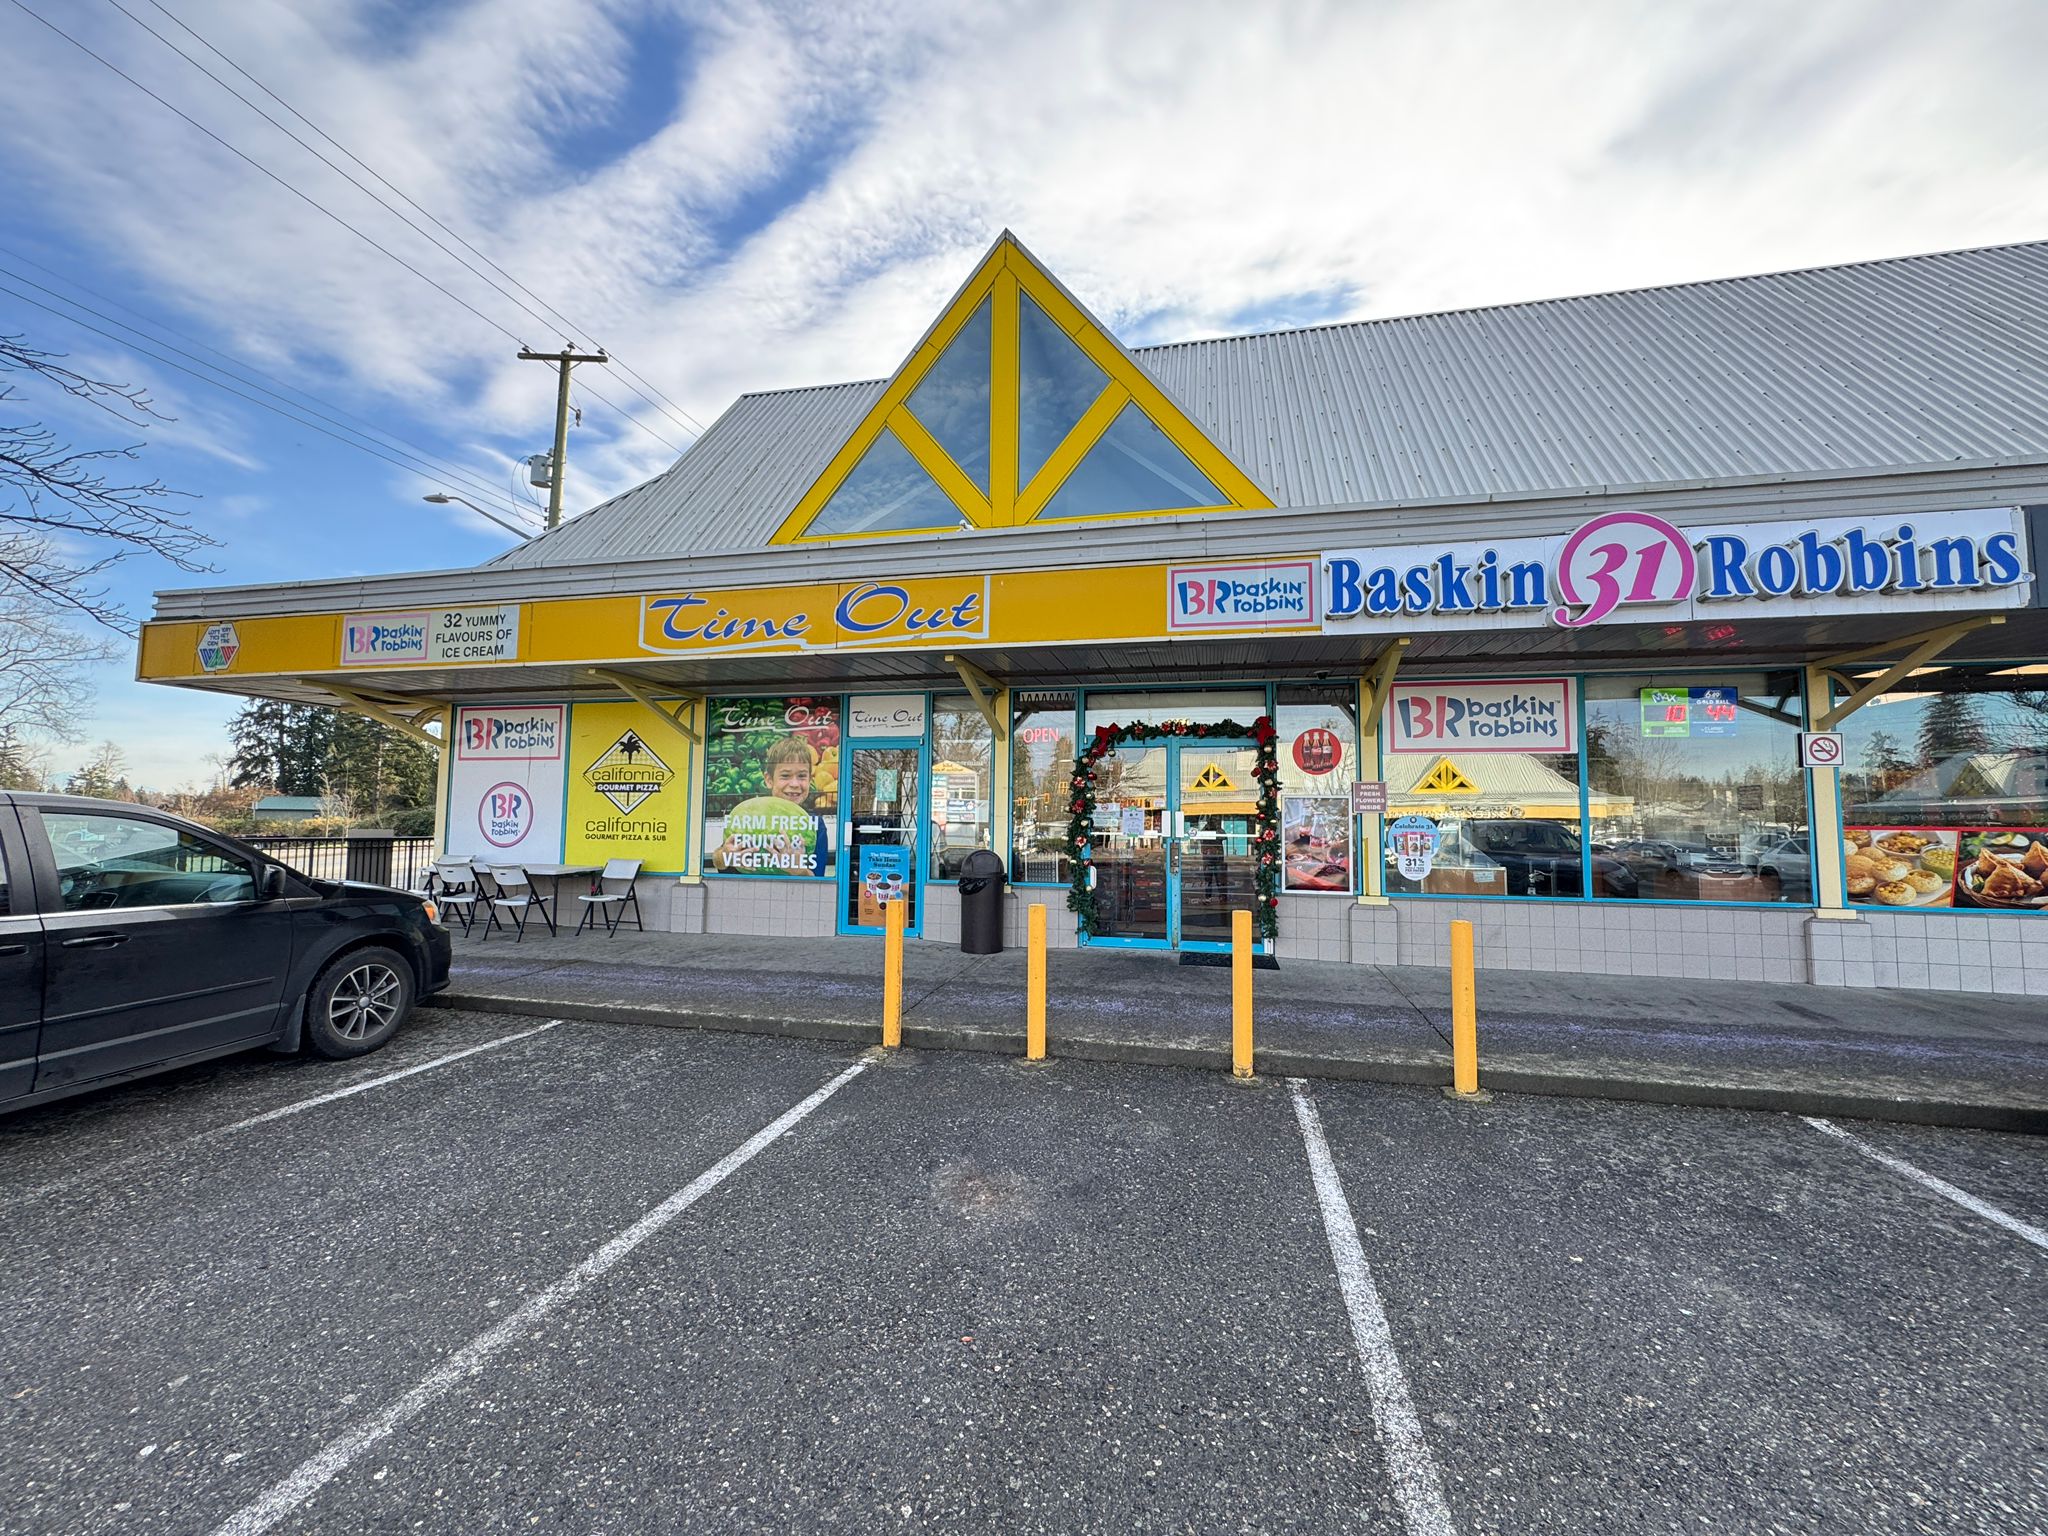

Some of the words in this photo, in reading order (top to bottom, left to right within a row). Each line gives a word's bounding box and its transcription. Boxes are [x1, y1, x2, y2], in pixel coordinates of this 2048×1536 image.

[1326, 549, 1549, 615] Baskin
[1554, 541, 1667, 627] 31
[1706, 524, 2021, 597] Robbins
[1231, 577, 1301, 597] baskin
[1177, 579, 1231, 615] BR
[1233, 595, 1304, 613] robbins
[649, 593, 811, 641] Time
[834, 581, 980, 633] Out
[444, 613, 462, 628] 32
[465, 614, 506, 627] YUMMY
[381, 624, 423, 638] baskin
[436, 631, 493, 643] FLAVOURS
[496, 629, 512, 640] OF
[349, 626, 381, 654] BR
[381, 638, 422, 651] robbins
[442, 648, 460, 658] ICE
[464, 645, 504, 657] CREAM
[1466, 694, 1555, 718] baskin
[720, 705, 776, 727] Time
[784, 704, 833, 726] Out
[852, 710, 888, 723] Time
[892, 708, 924, 723] Out
[1397, 696, 1465, 738] BR
[464, 718, 504, 750] BR
[504, 717, 555, 735] baskin
[1469, 716, 1558, 738] robbins
[504, 733, 555, 749] robbins
[1023, 727, 1059, 744] OPEN
[592, 767, 665, 781] california
[491, 793, 522, 818] BR
[492, 819, 519, 828] baskin
[585, 817, 667, 833] california
[723, 815, 766, 830] FARM
[771, 815, 819, 831] FRESH
[492, 828, 518, 837] robbins
[733, 834, 785, 849] FRUITS
[791, 835, 801, 849] &
[722, 852, 818, 870] VEGETABLES
